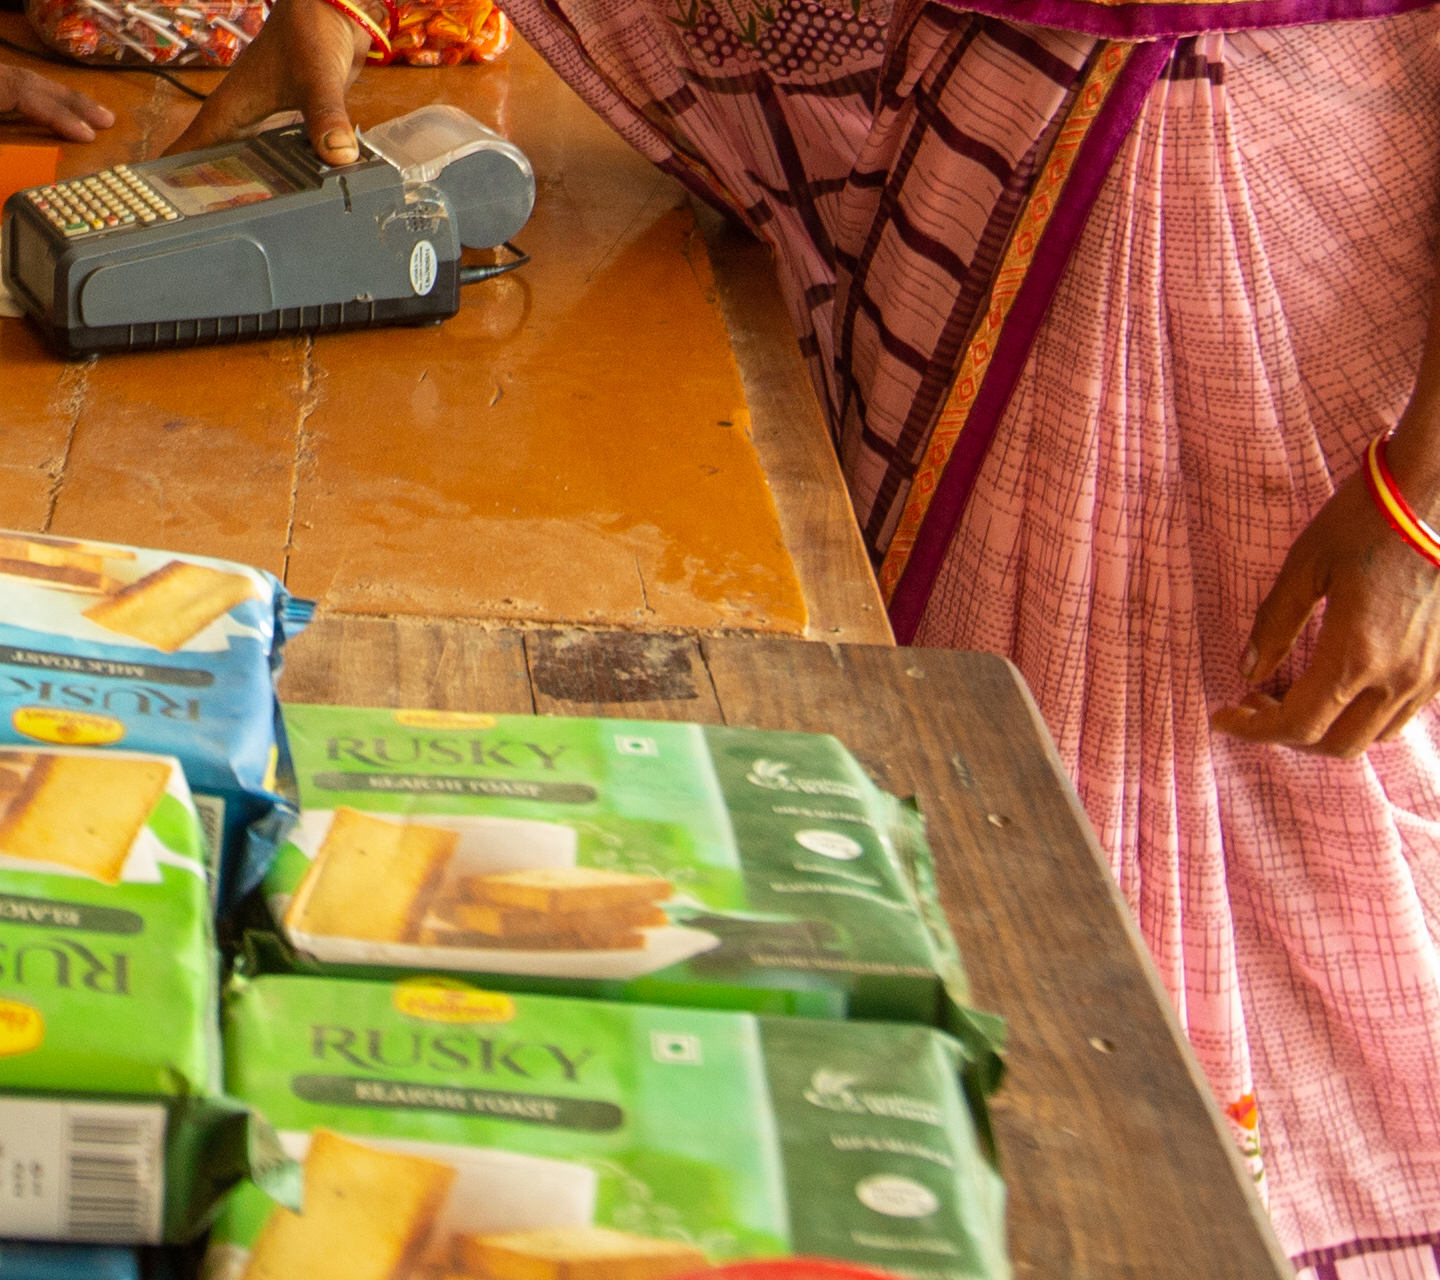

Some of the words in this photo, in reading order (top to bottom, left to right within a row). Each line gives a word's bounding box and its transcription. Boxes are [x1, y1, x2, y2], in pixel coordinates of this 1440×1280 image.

[10, 651, 82, 672] TOAST
[84, 660, 145, 678] MILK
[326, 737, 567, 771] RUSKY
[310, 1024, 595, 1084] RUSKY
